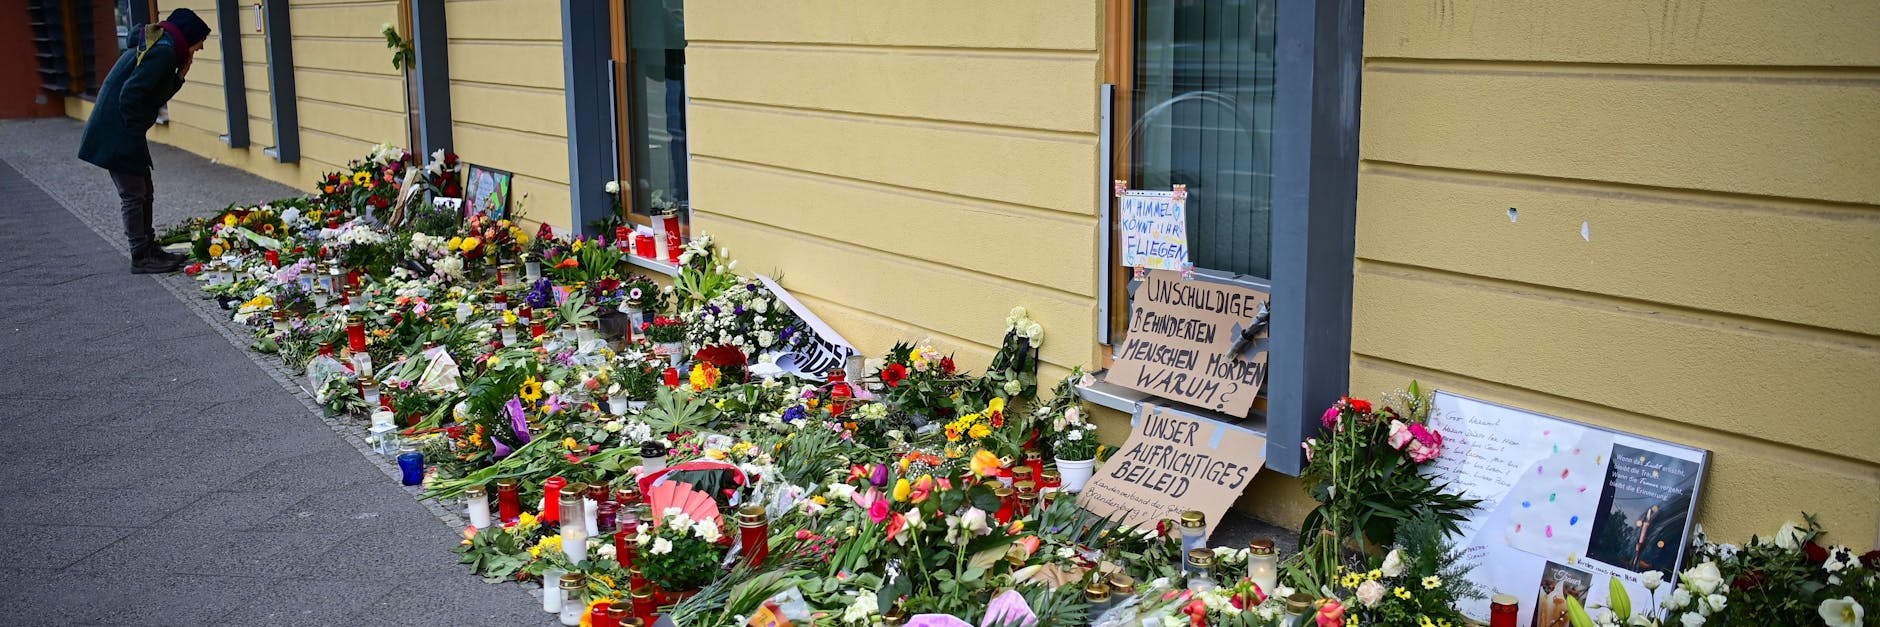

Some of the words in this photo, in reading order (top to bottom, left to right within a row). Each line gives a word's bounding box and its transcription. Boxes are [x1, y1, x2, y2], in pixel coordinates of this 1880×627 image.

[1122, 199, 1132, 214] IM
[1136, 201, 1172, 217] HIMMEL
[1127, 236, 1188, 261] FLIEGEN
[1147, 276, 1256, 319] UNSCHULDIGE
[1130, 307, 1217, 345] BEHINDERTEN
[1121, 339, 1200, 371] MENSCHEN
[1143, 414, 1200, 447] UNSER
[1110, 460, 1190, 499] BEILEID
[1124, 441, 1249, 490] AUFRICHTIGES
